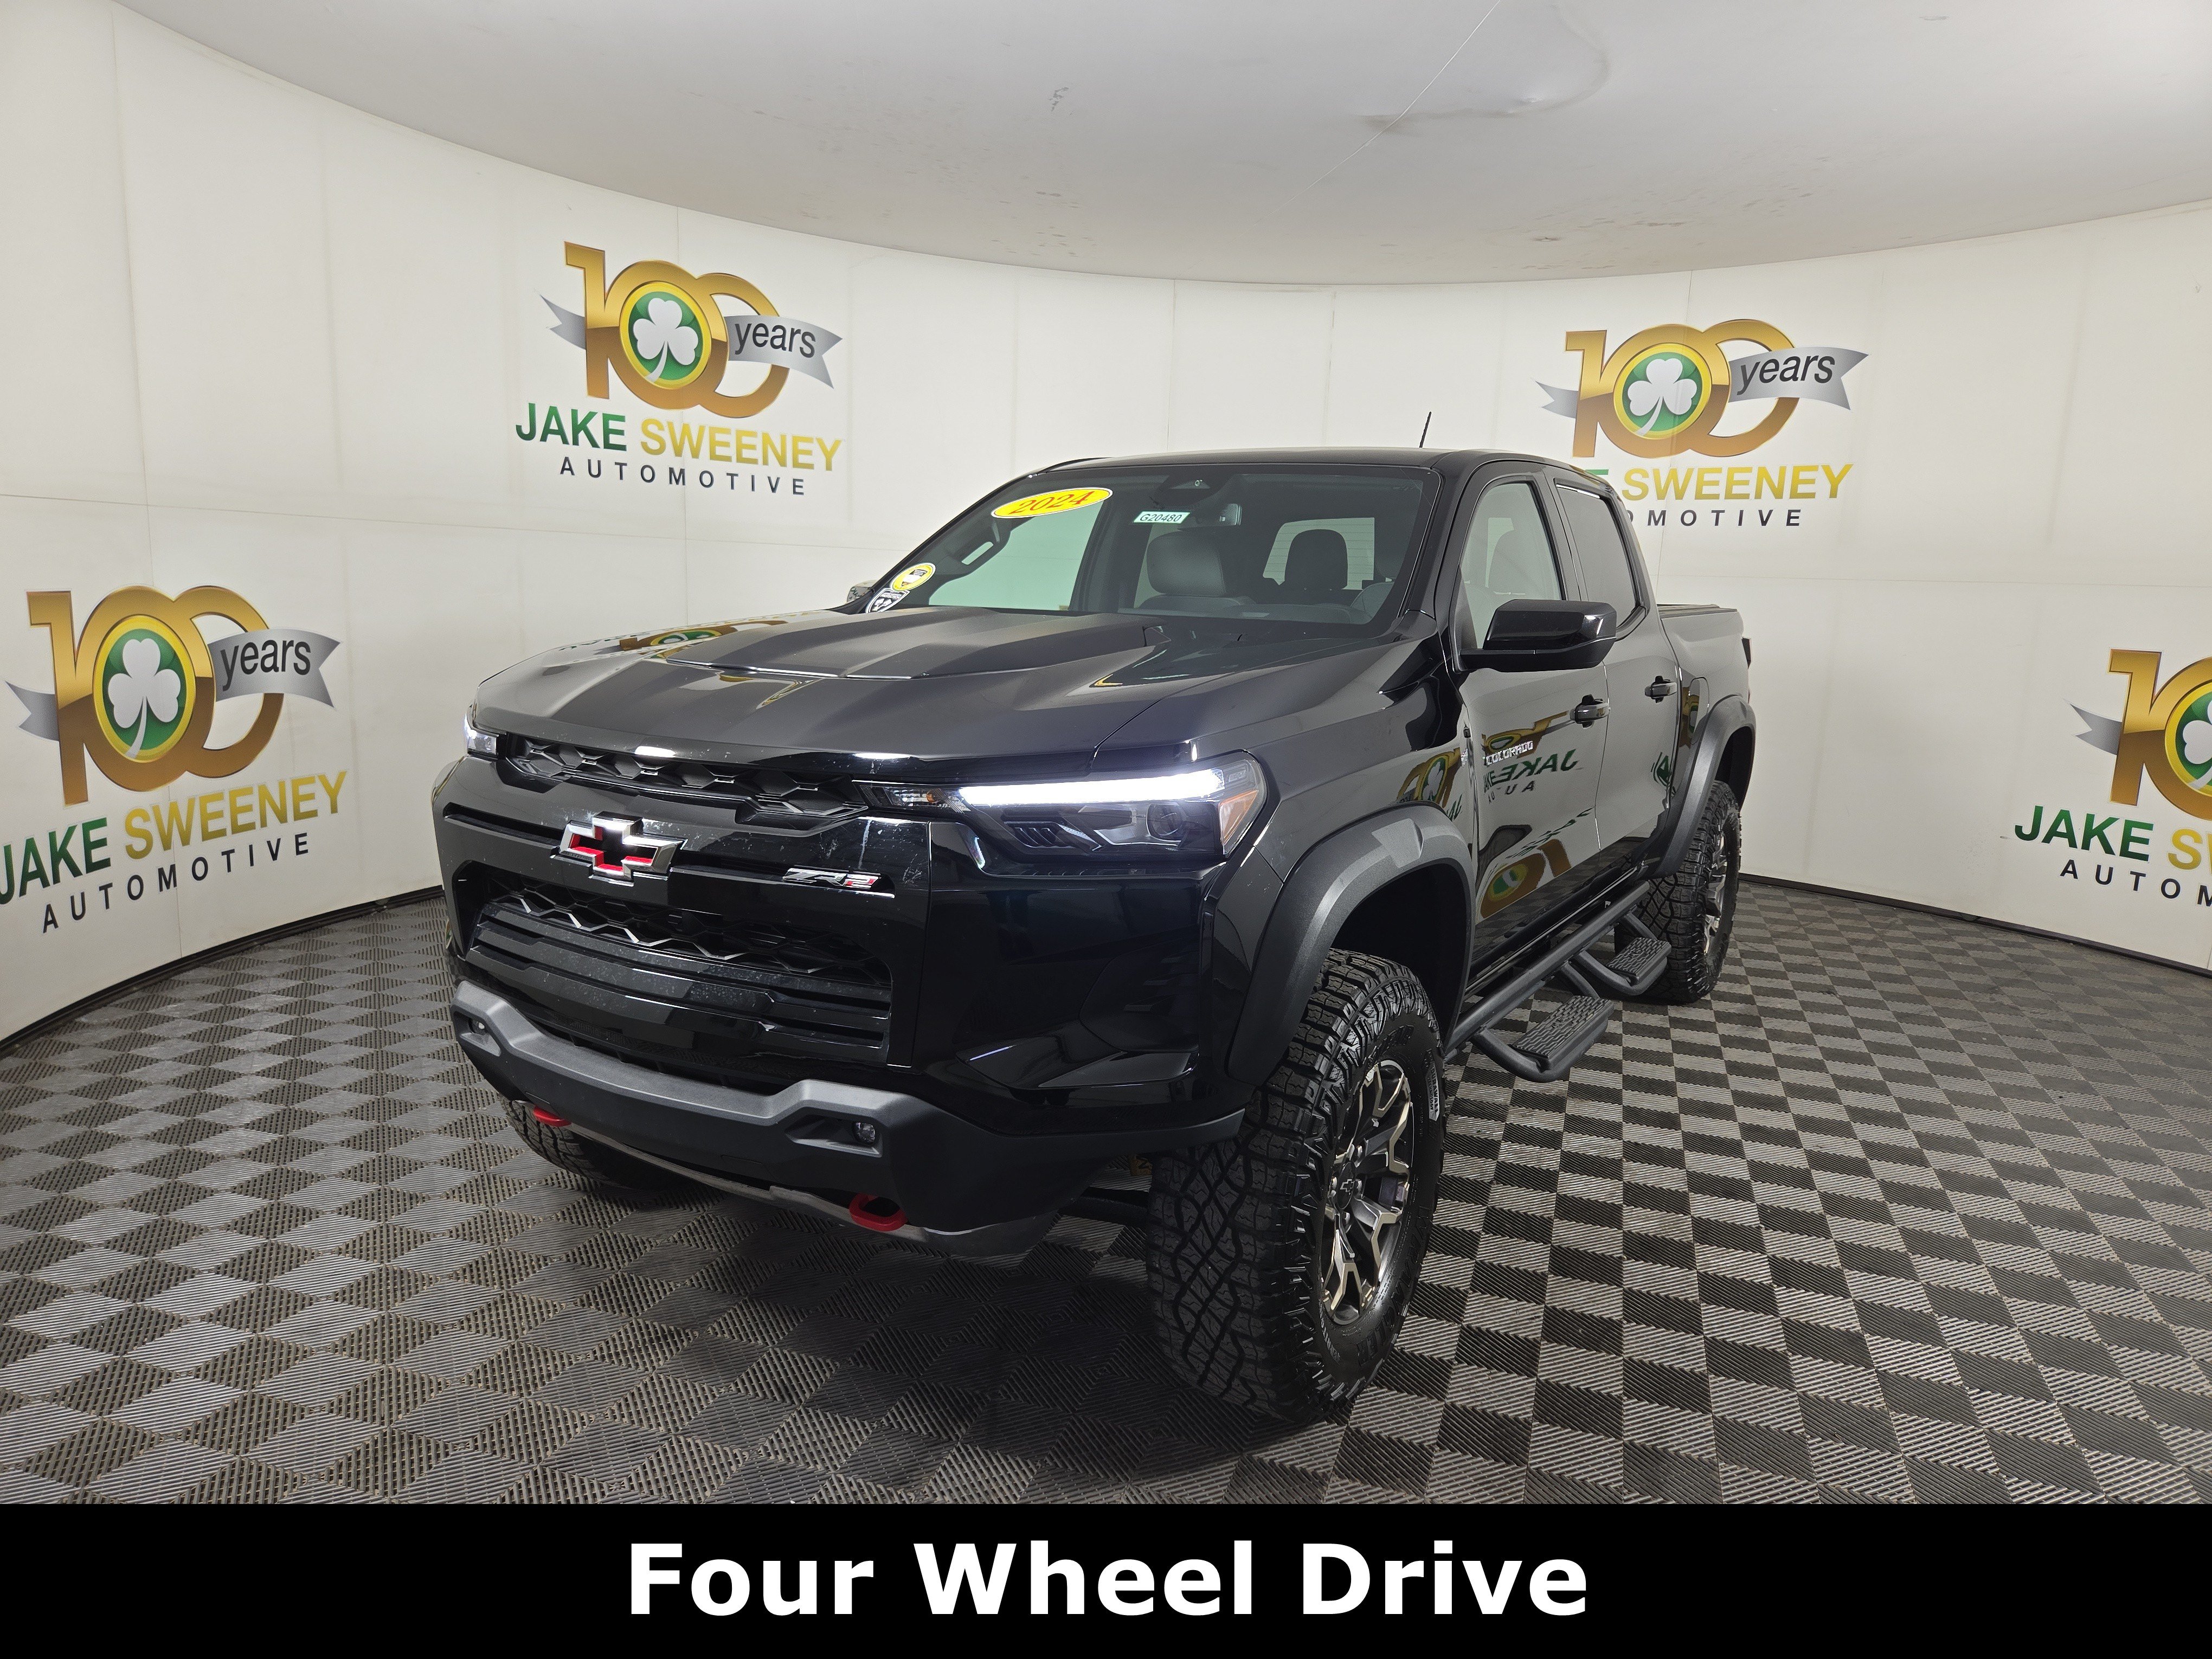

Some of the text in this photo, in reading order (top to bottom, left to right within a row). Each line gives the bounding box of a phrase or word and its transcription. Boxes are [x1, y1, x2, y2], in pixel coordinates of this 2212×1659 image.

[564, 241, 816, 419] 100 years
[1565, 319, 1835, 458] 100 years
[516, 402, 841, 472] JAKE SWEENEY
[560, 456, 805, 496] AUTOMOTIVE
[1621, 463, 1854, 500] SWEENEY
[1009, 491, 1095, 515] 2024
[1140, 513, 1182, 522] G20480
[1627, 509, 1801, 526] MOTIVE
[26, 585, 312, 805] 100 years
[1484, 741, 1534, 765] COLORADO
[0, 771, 348, 905] JAKE SWEENEY
[2015, 805, 2155, 862] JAKE
[43, 832, 309, 934] AUTOMOTIVE
[782, 867, 879, 889] ZR2
